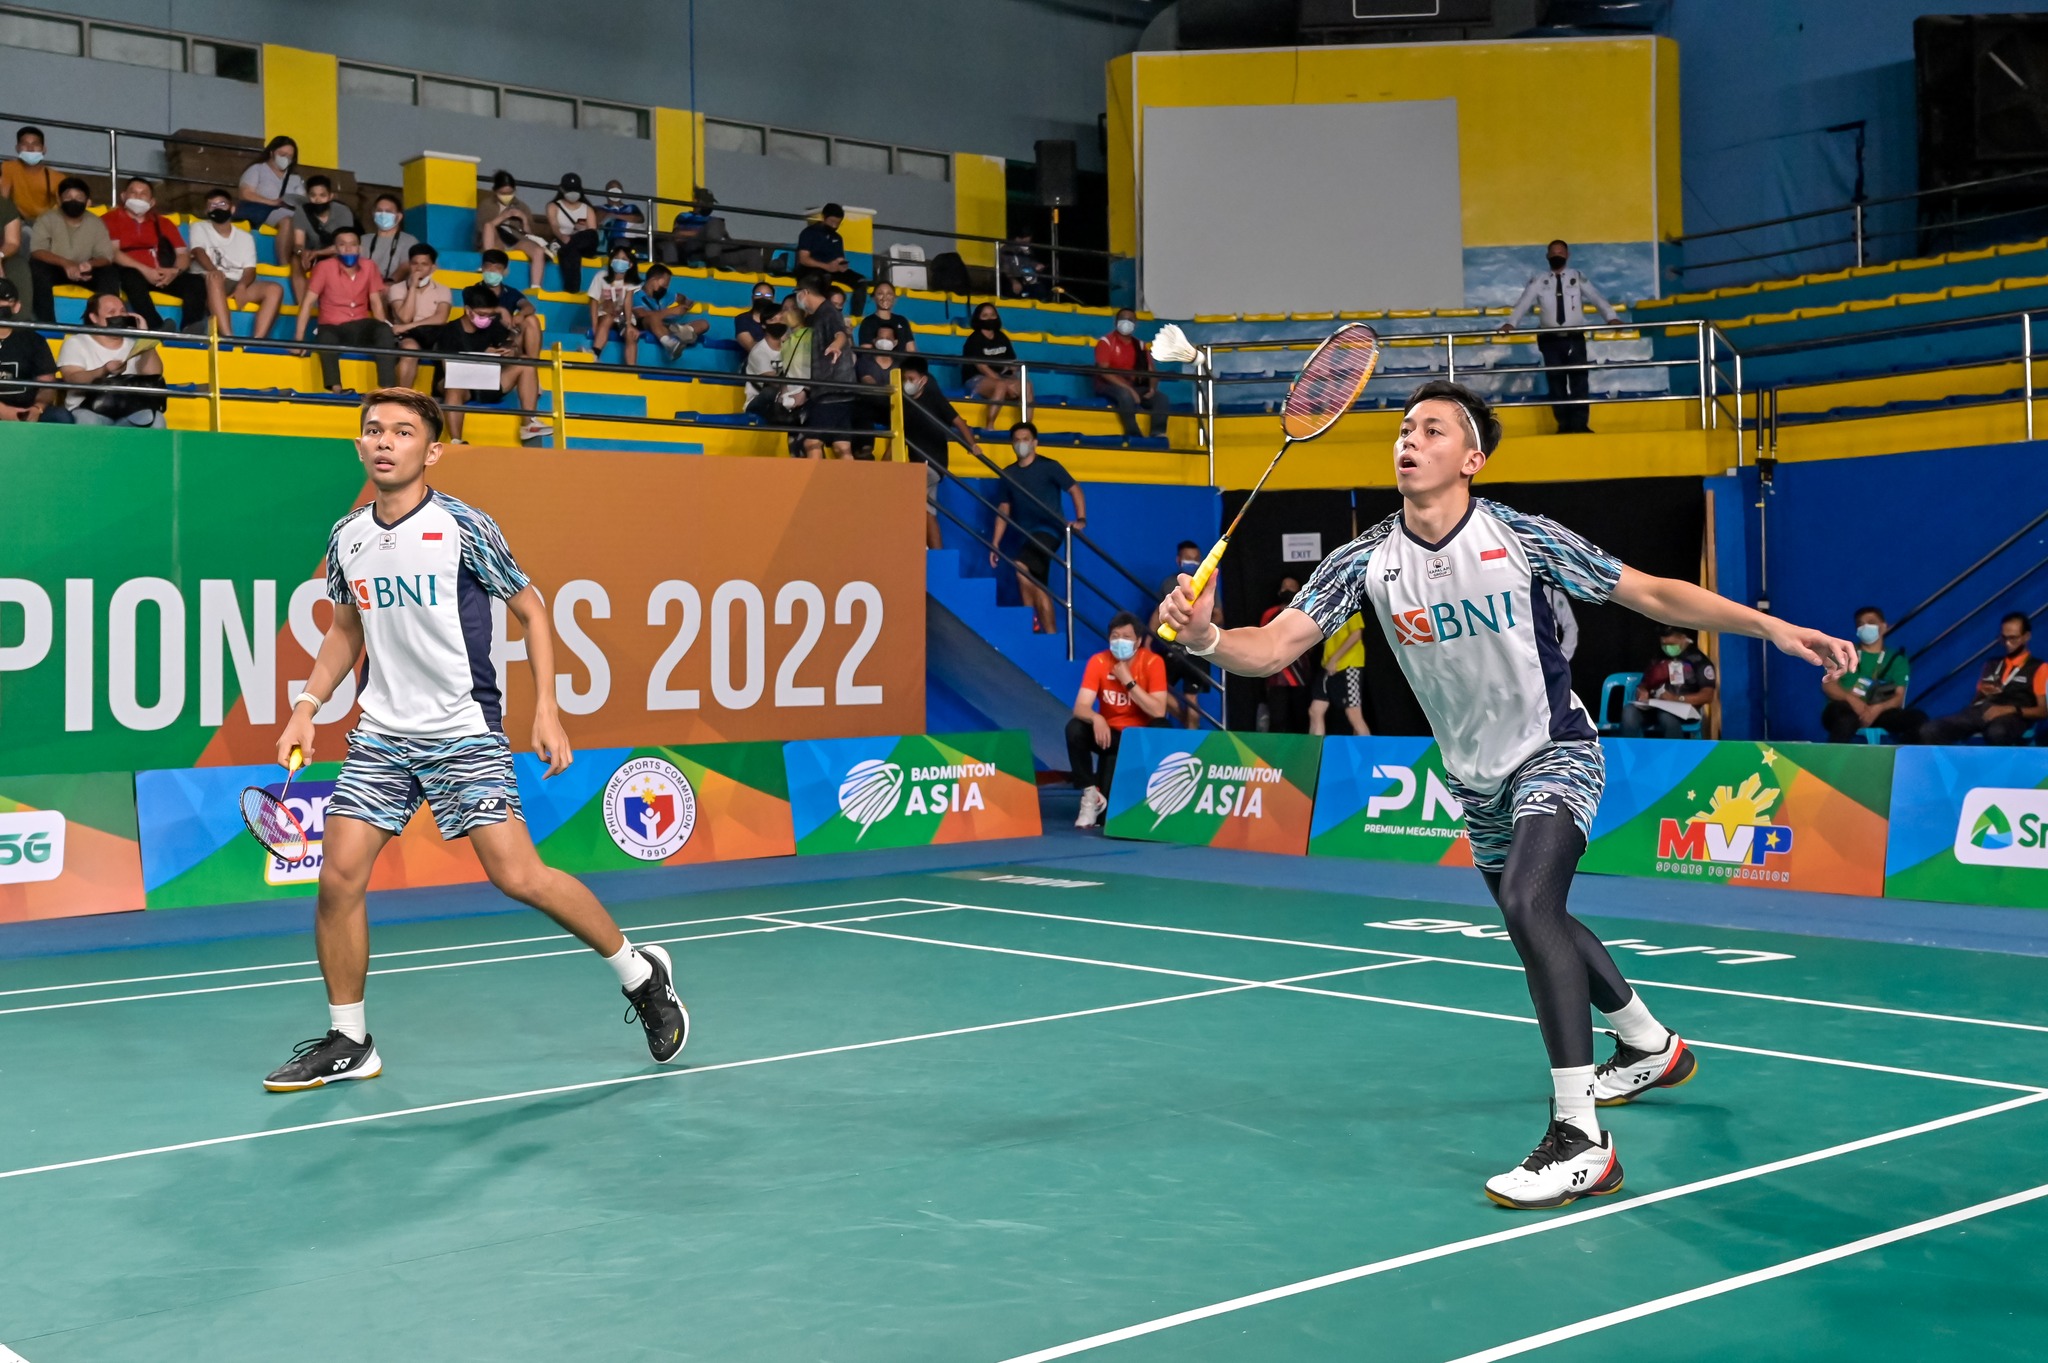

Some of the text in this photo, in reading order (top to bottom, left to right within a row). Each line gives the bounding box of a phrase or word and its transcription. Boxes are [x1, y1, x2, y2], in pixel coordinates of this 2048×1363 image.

[1290, 550, 1312, 560] EXIT
[373, 574, 438, 608] BNI
[1430, 591, 1516, 642] BNI
[647, 580, 883, 711] 2022
[911, 763, 996, 782] BADMINTON
[1207, 764, 1282, 783] BADMINTON
[605, 760, 694, 835] PHILIPPINE SPORTS COMMISSION
[904, 782, 985, 816] ASIA
[1194, 783, 1262, 818] ASIA
[1364, 823, 1404, 836] PREMIUM
[1657, 818, 1793, 866] MVP
[641, 847, 667, 857] 1990
[1656, 861, 1790, 882] SPORTS FOUNDATION
